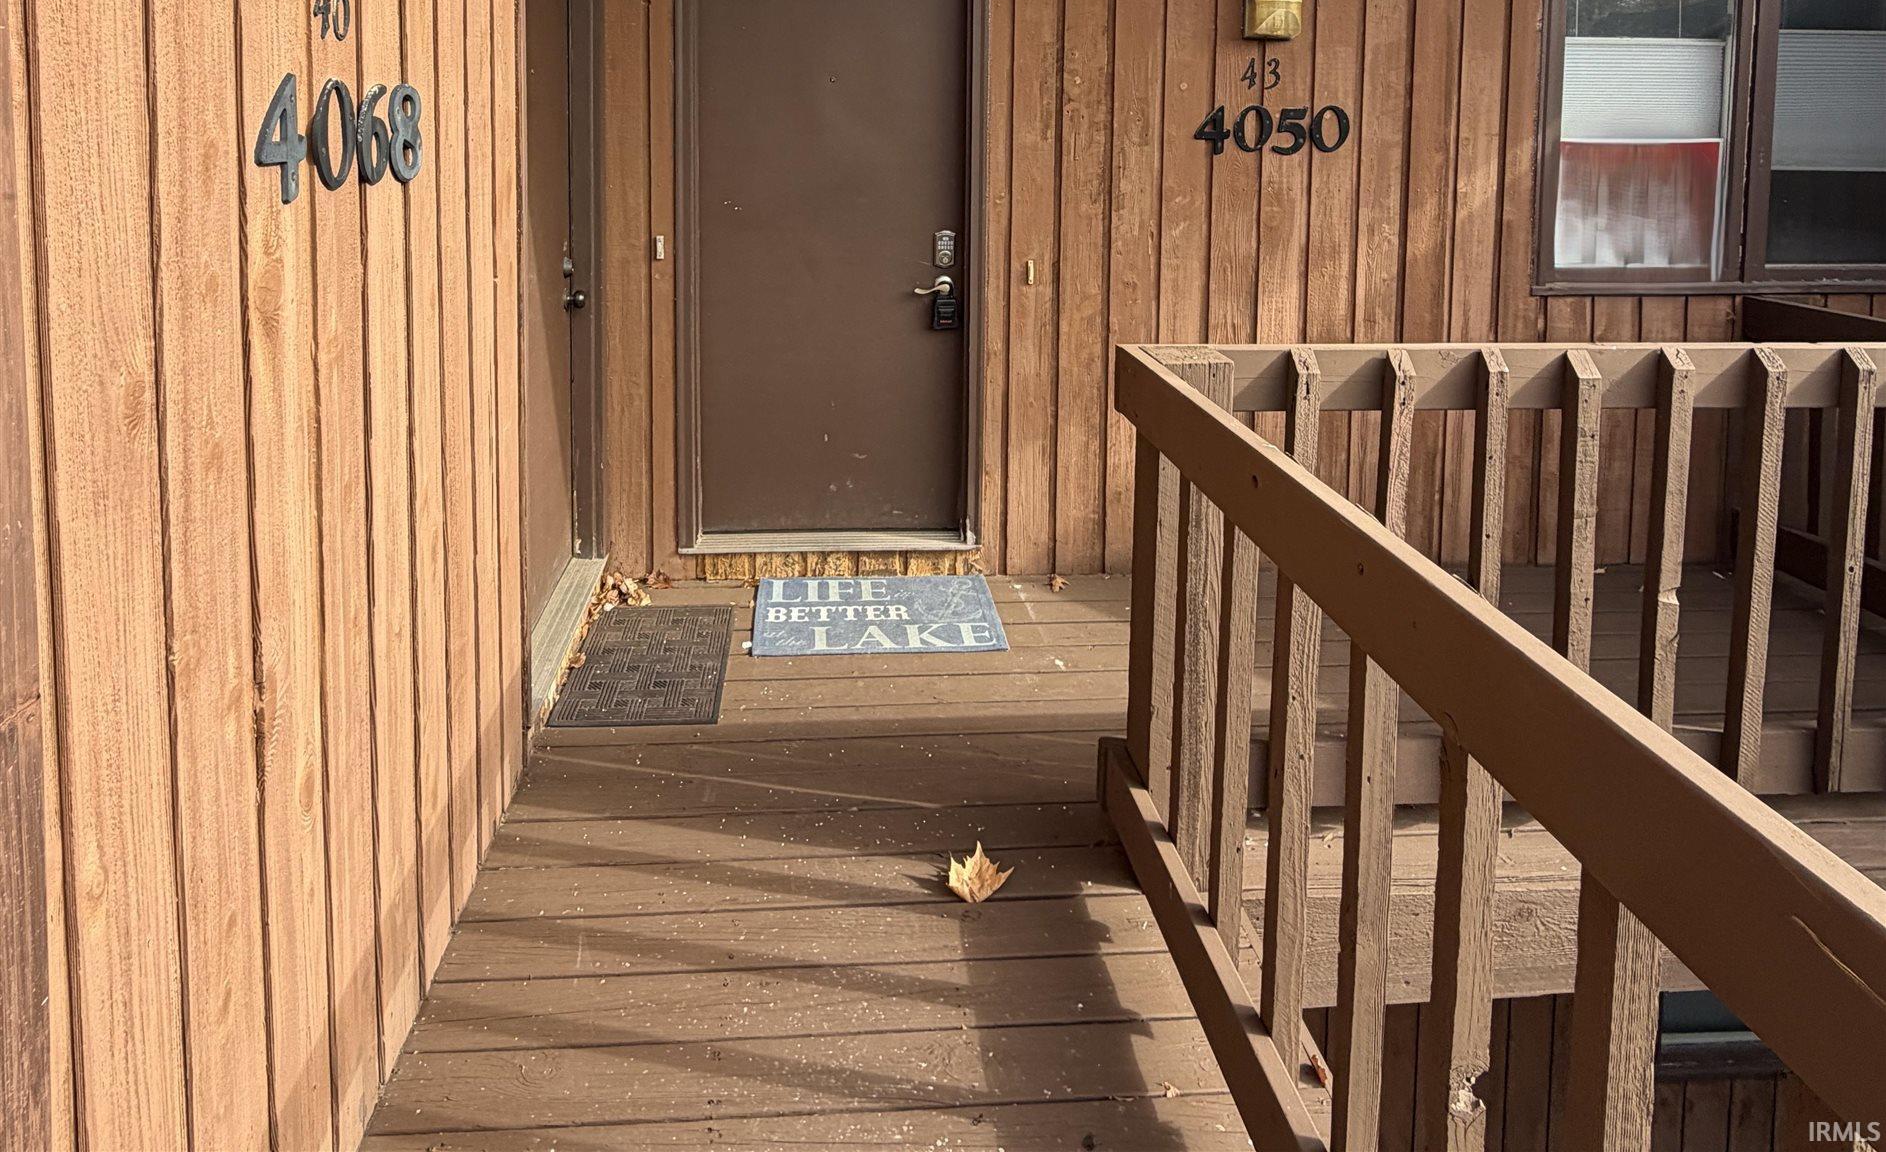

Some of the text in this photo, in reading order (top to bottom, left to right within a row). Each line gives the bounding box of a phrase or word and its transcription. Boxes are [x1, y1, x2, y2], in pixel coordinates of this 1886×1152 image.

[1241, 57, 1281, 90] 43
[254, 73, 422, 204] 4068
[1194, 105, 1350, 155] 4050
[769, 579, 891, 603] LIFE
[765, 605, 910, 622] BETTER
[810, 623, 997, 650] LAKE
